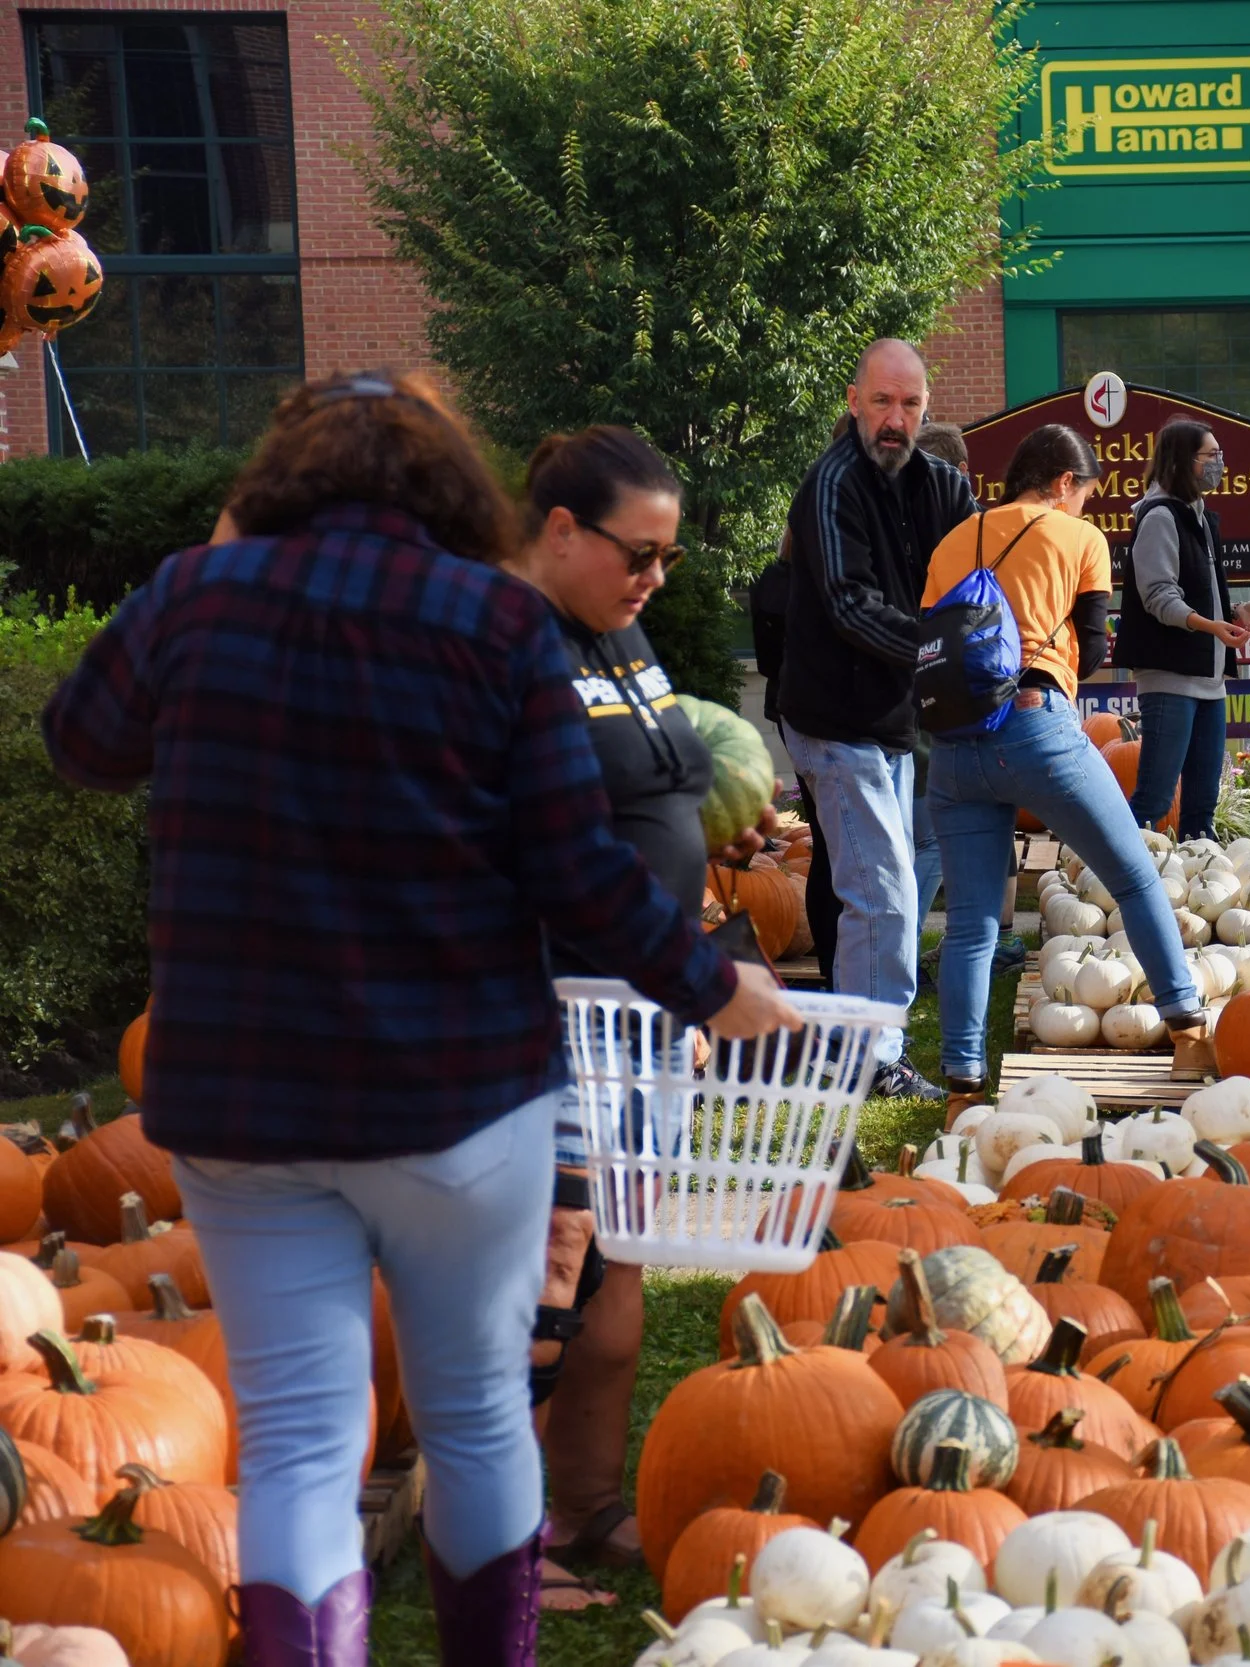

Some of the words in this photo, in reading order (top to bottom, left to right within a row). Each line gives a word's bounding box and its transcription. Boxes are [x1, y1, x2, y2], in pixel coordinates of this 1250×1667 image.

[1065, 74, 1242, 126] Howard
[1065, 112, 1218, 153] Hanna
[1232, 544, 1250, 553] AM
[918, 637, 943, 661] RMU
